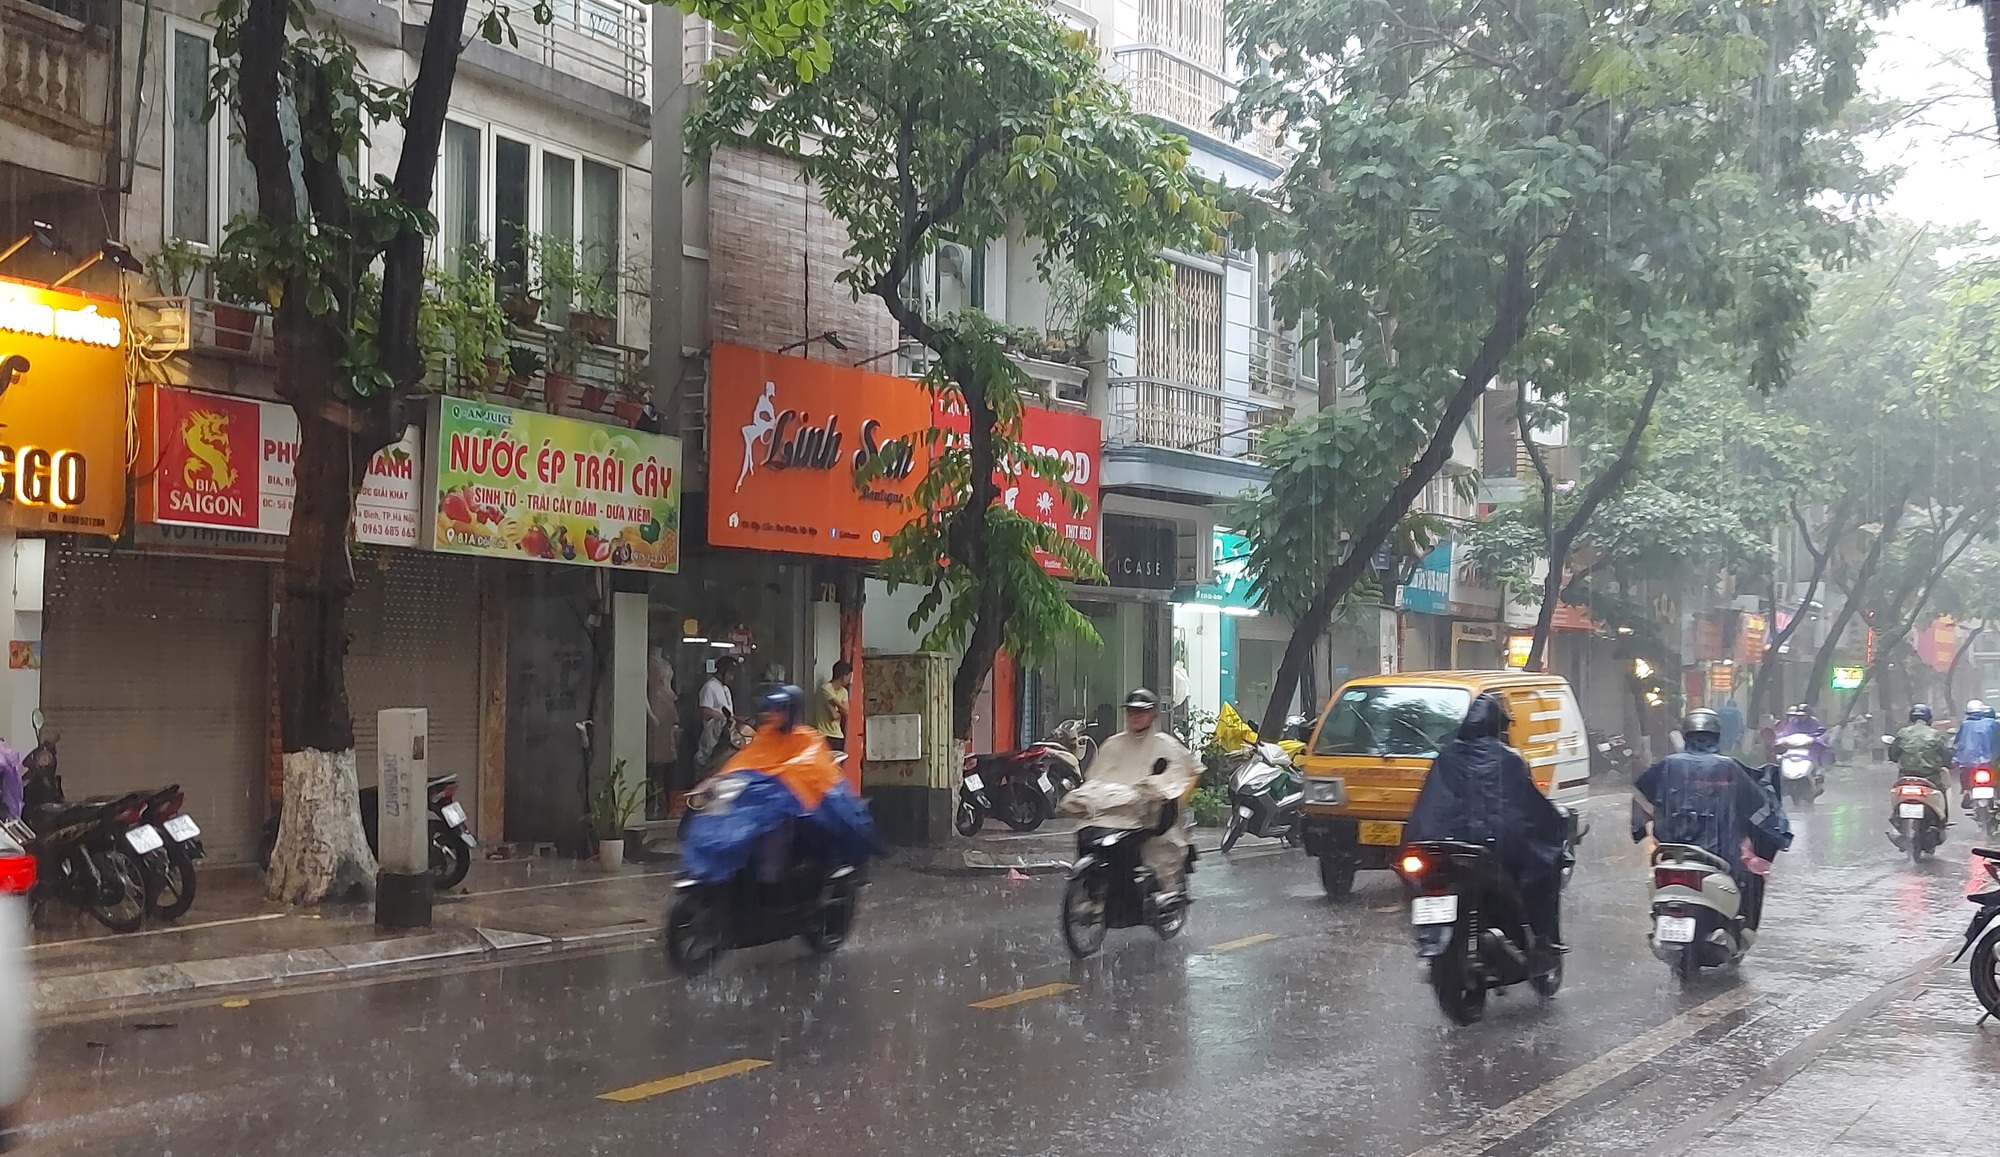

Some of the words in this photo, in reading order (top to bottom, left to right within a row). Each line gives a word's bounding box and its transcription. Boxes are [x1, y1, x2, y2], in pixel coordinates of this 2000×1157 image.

[485, 412, 513, 426] JUICE
[451, 431, 528, 481] NƯỚC
[537, 439, 566, 484] ÉP
[574, 449, 623, 493] TRÁI
[632, 456, 672, 498] CÂY
[196, 478, 218, 493] BIA
[170, 489, 242, 517] SAIGON
[475, 487, 499, 507] SINH
[527, 493, 549, 511] TRÁI
[553, 495, 571, 513] CÂY
[628, 505, 651, 523] XIÊM
[363, 523, 382, 535] 0963
